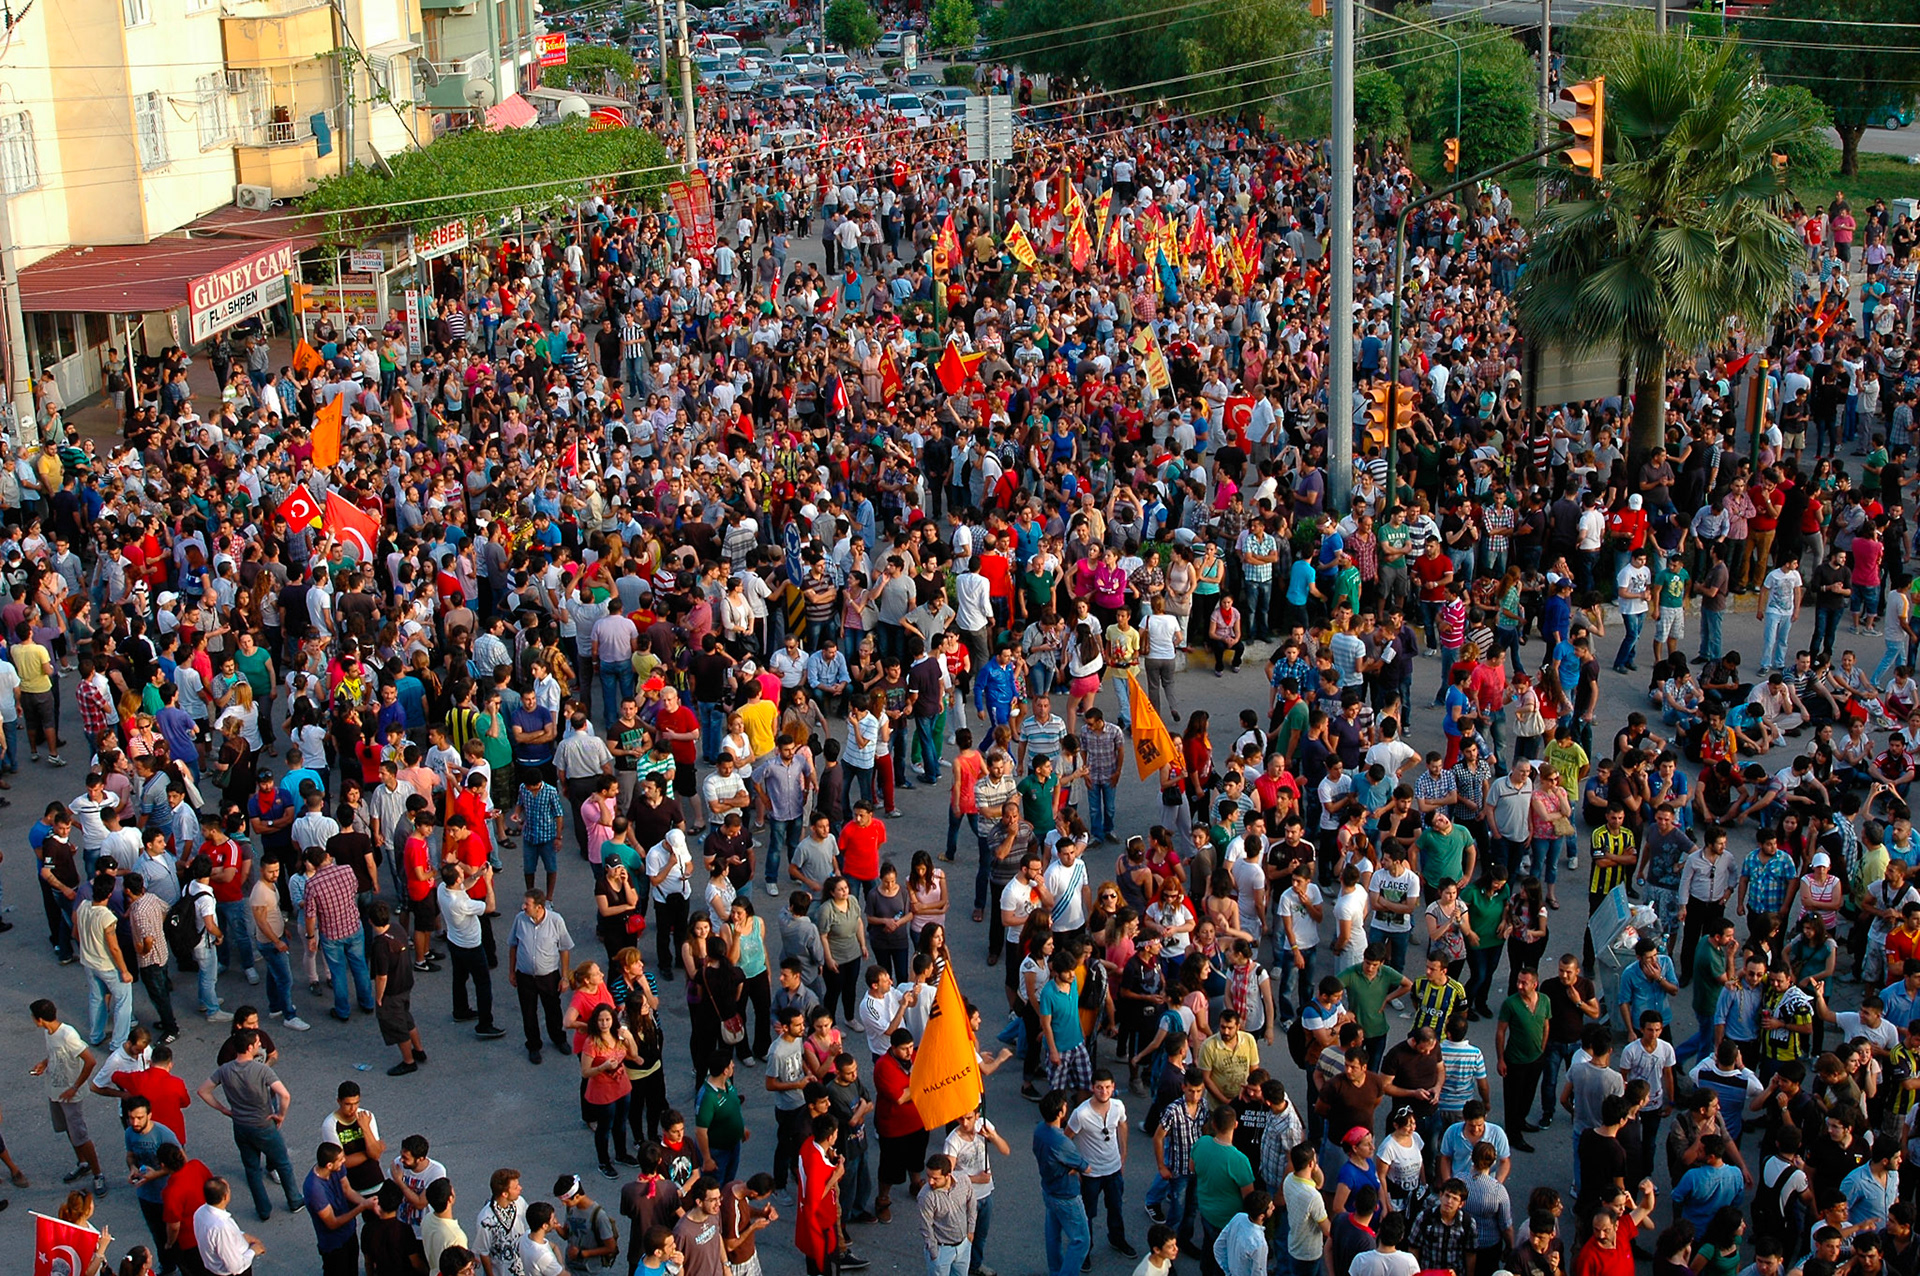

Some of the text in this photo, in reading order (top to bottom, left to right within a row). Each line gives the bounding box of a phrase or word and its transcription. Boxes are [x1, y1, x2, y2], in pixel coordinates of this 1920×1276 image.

[193, 262, 253, 309] GÜNEY
[255, 246, 292, 281] CAM
[209, 289, 258, 329] FLASHPEN
[407, 291, 418, 342] BERBER
